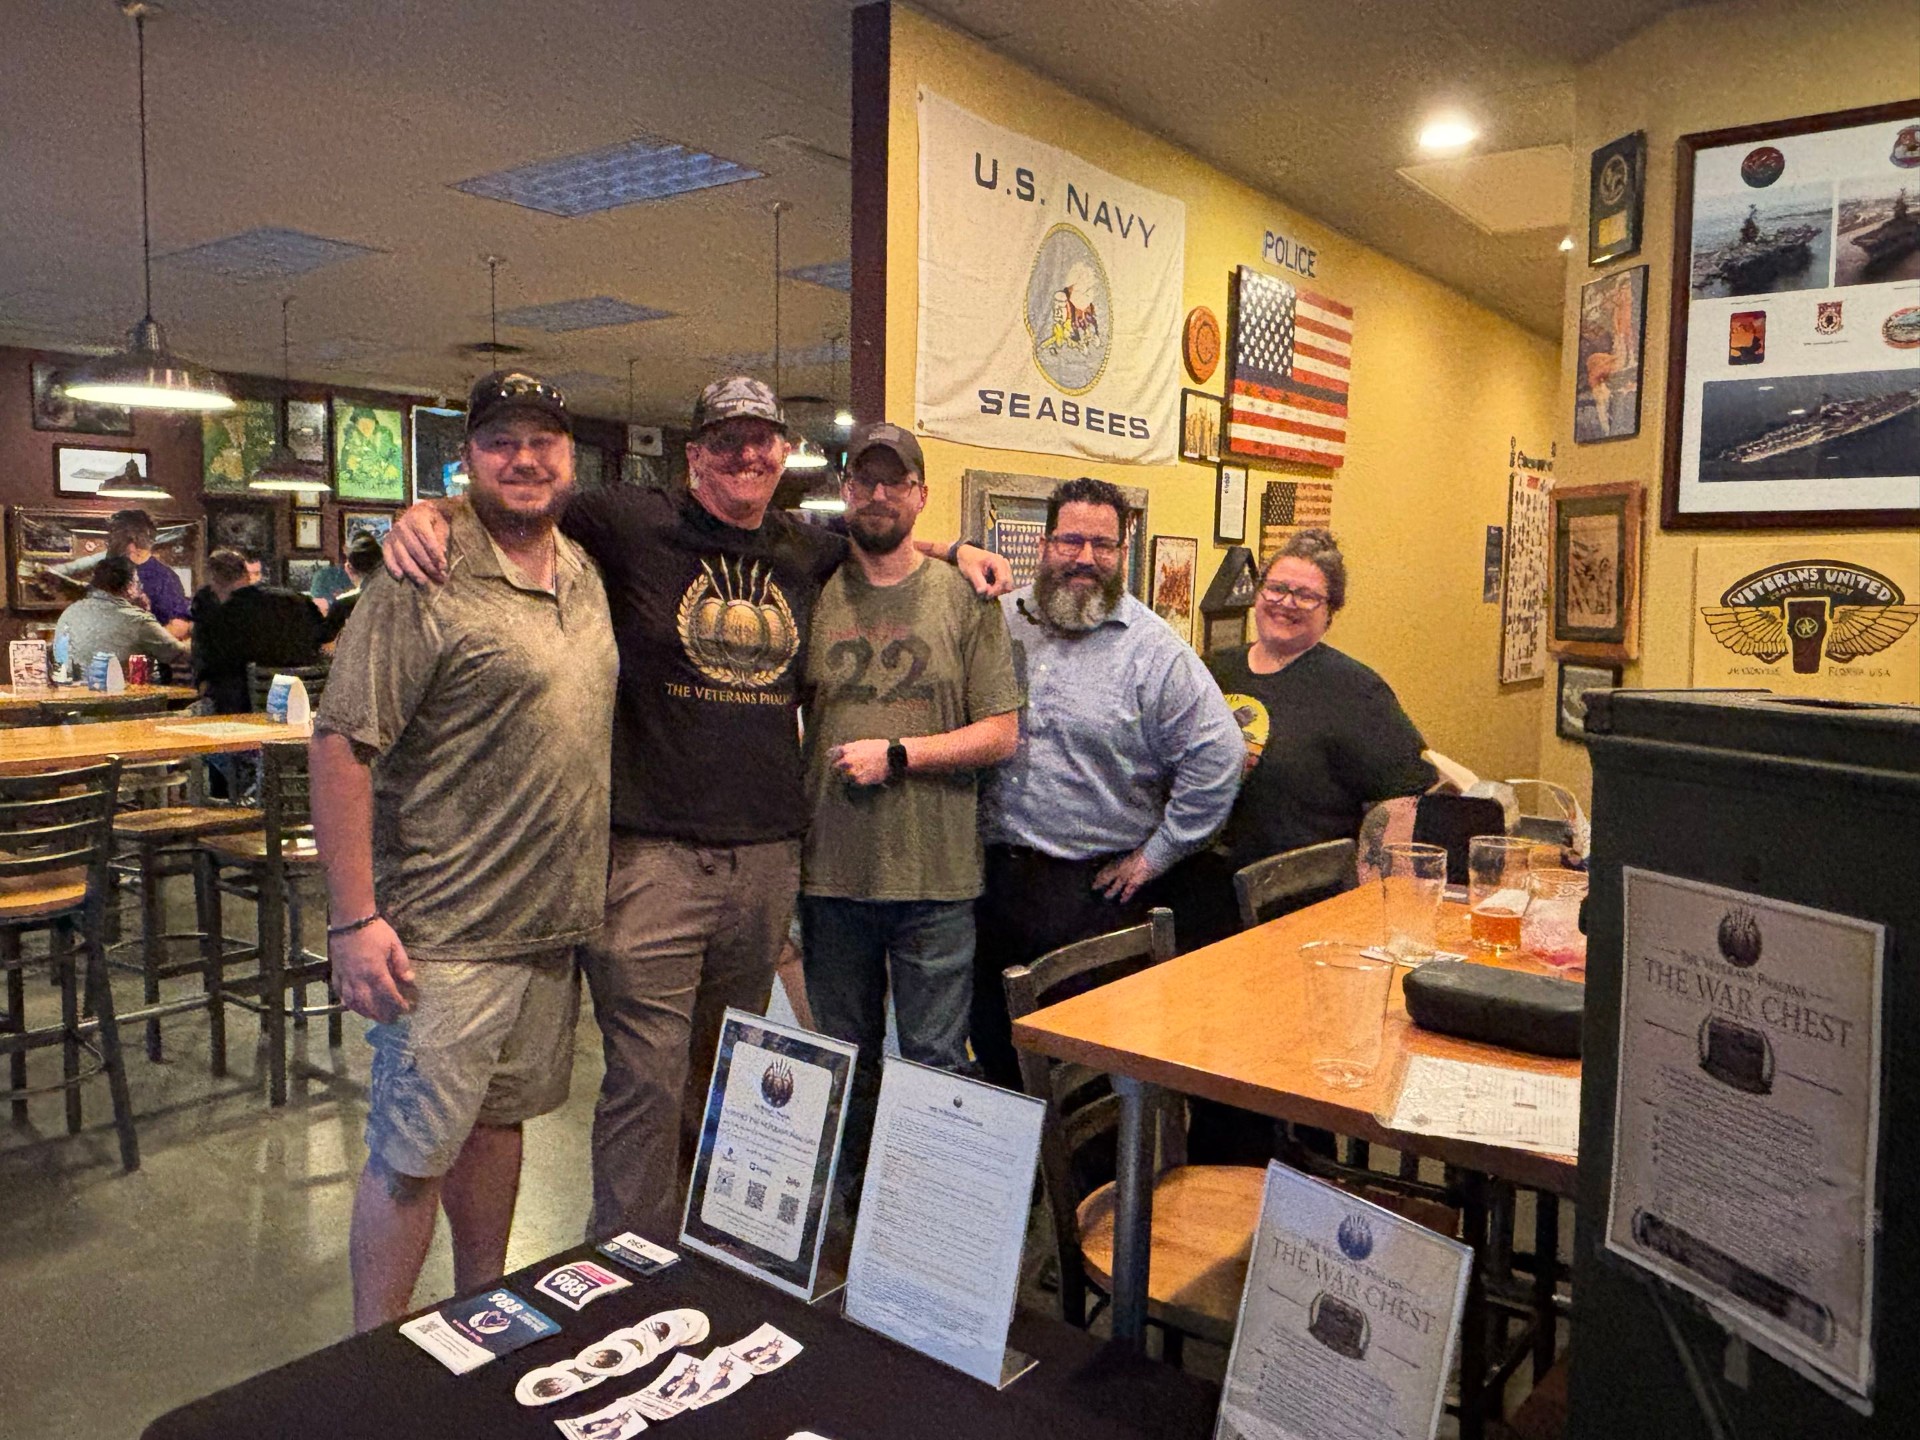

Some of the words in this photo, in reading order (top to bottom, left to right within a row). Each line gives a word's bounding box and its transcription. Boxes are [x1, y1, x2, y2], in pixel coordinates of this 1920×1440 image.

[975, 151, 1046, 206] U.S.
[1066, 182, 1156, 249] NAVY
[1264, 230, 1317, 279] POLICE
[977, 389, 1151, 440] SEABEES
[1731, 567, 1820, 606] VETERANS
[1824, 569, 1893, 602] UNITED
[665, 682, 692, 698] THE
[694, 686, 757, 705] VETERANS
[1644, 956, 1689, 995] THE
[1696, 974, 1753, 1015] WAR
[1761, 995, 1854, 1048] CHEST
[488, 1292, 524, 1314] 988
[551, 1273, 589, 1297] 988
[1273, 1236, 1309, 1273] THE
[1316, 1256, 1360, 1298] WAR
[1364, 1284, 1437, 1335] CHEST
